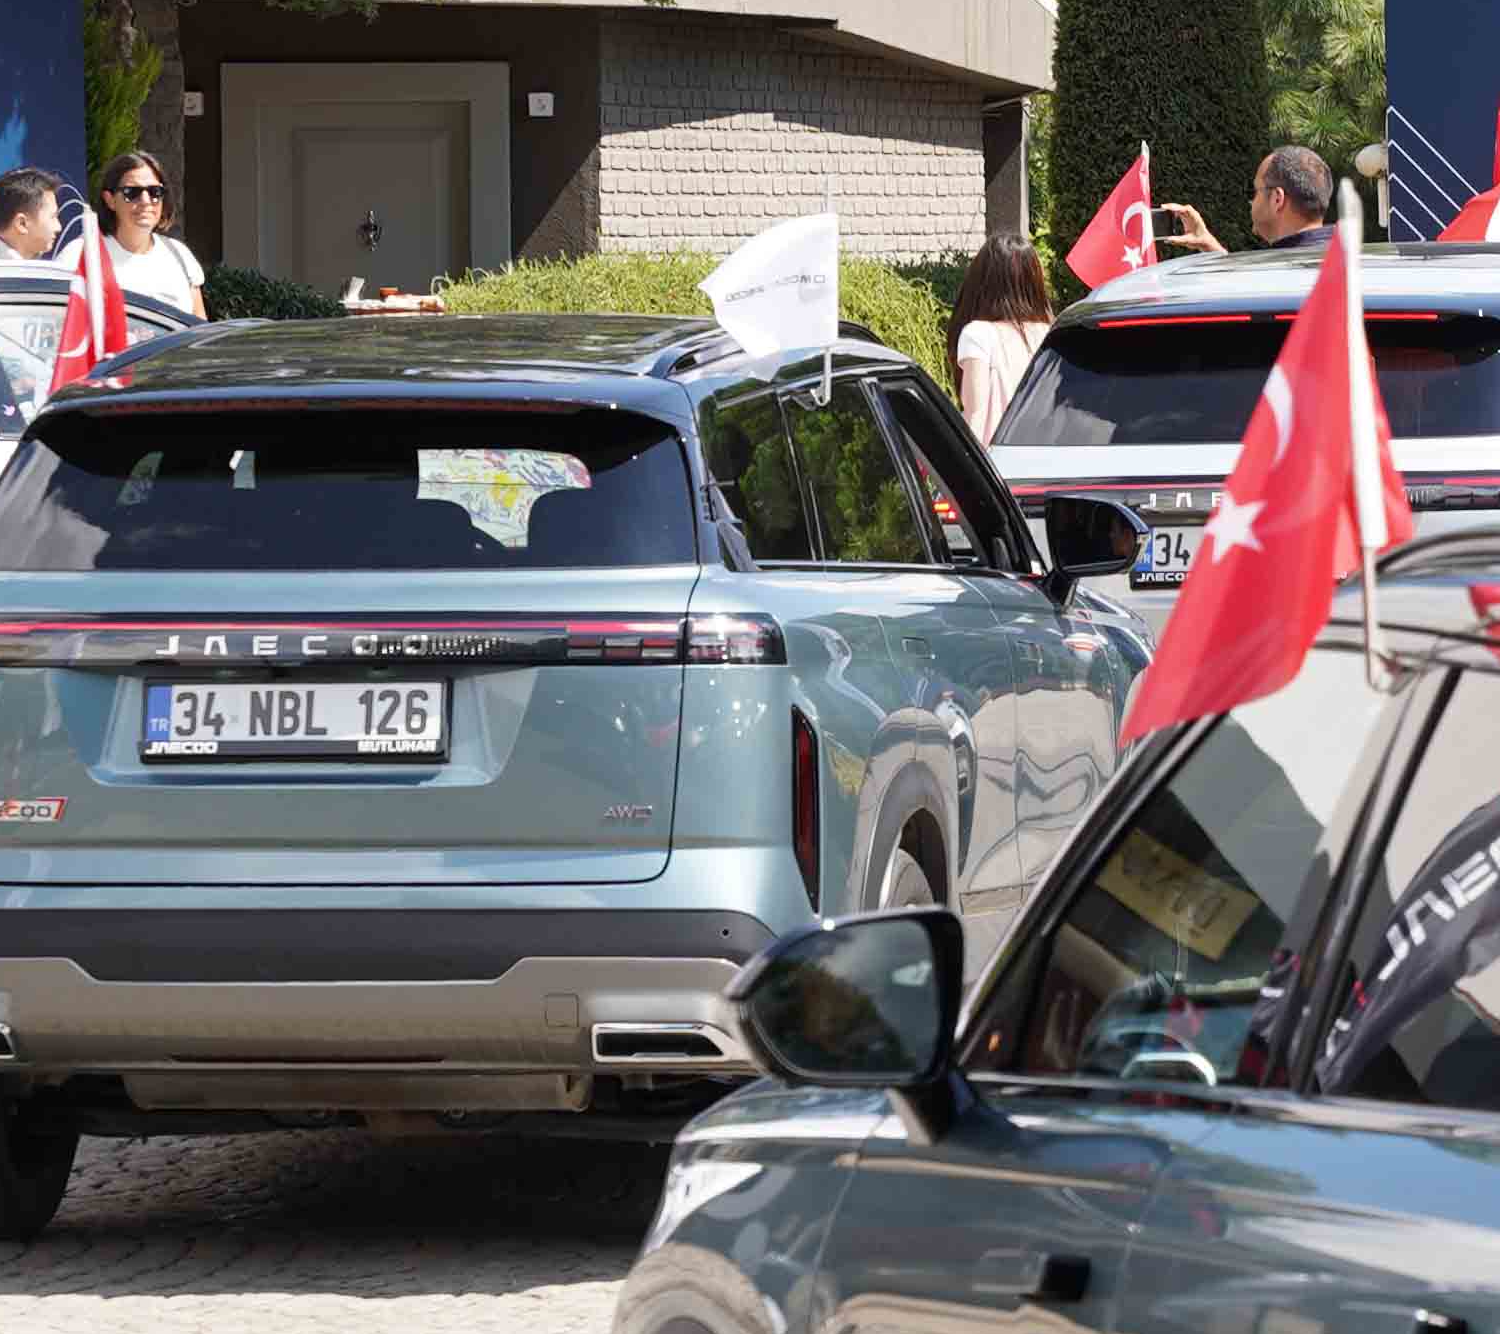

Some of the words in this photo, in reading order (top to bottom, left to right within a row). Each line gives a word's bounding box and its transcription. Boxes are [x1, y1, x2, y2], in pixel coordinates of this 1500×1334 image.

[1155, 533, 1191, 566] 34
[1136, 572, 1189, 582] JAECO
[156, 634, 429, 656] JAECOO
[174, 691, 225, 737] 34
[248, 690, 328, 737] NBL
[358, 689, 430, 736] 126
[145, 741, 219, 755] JAECOO
